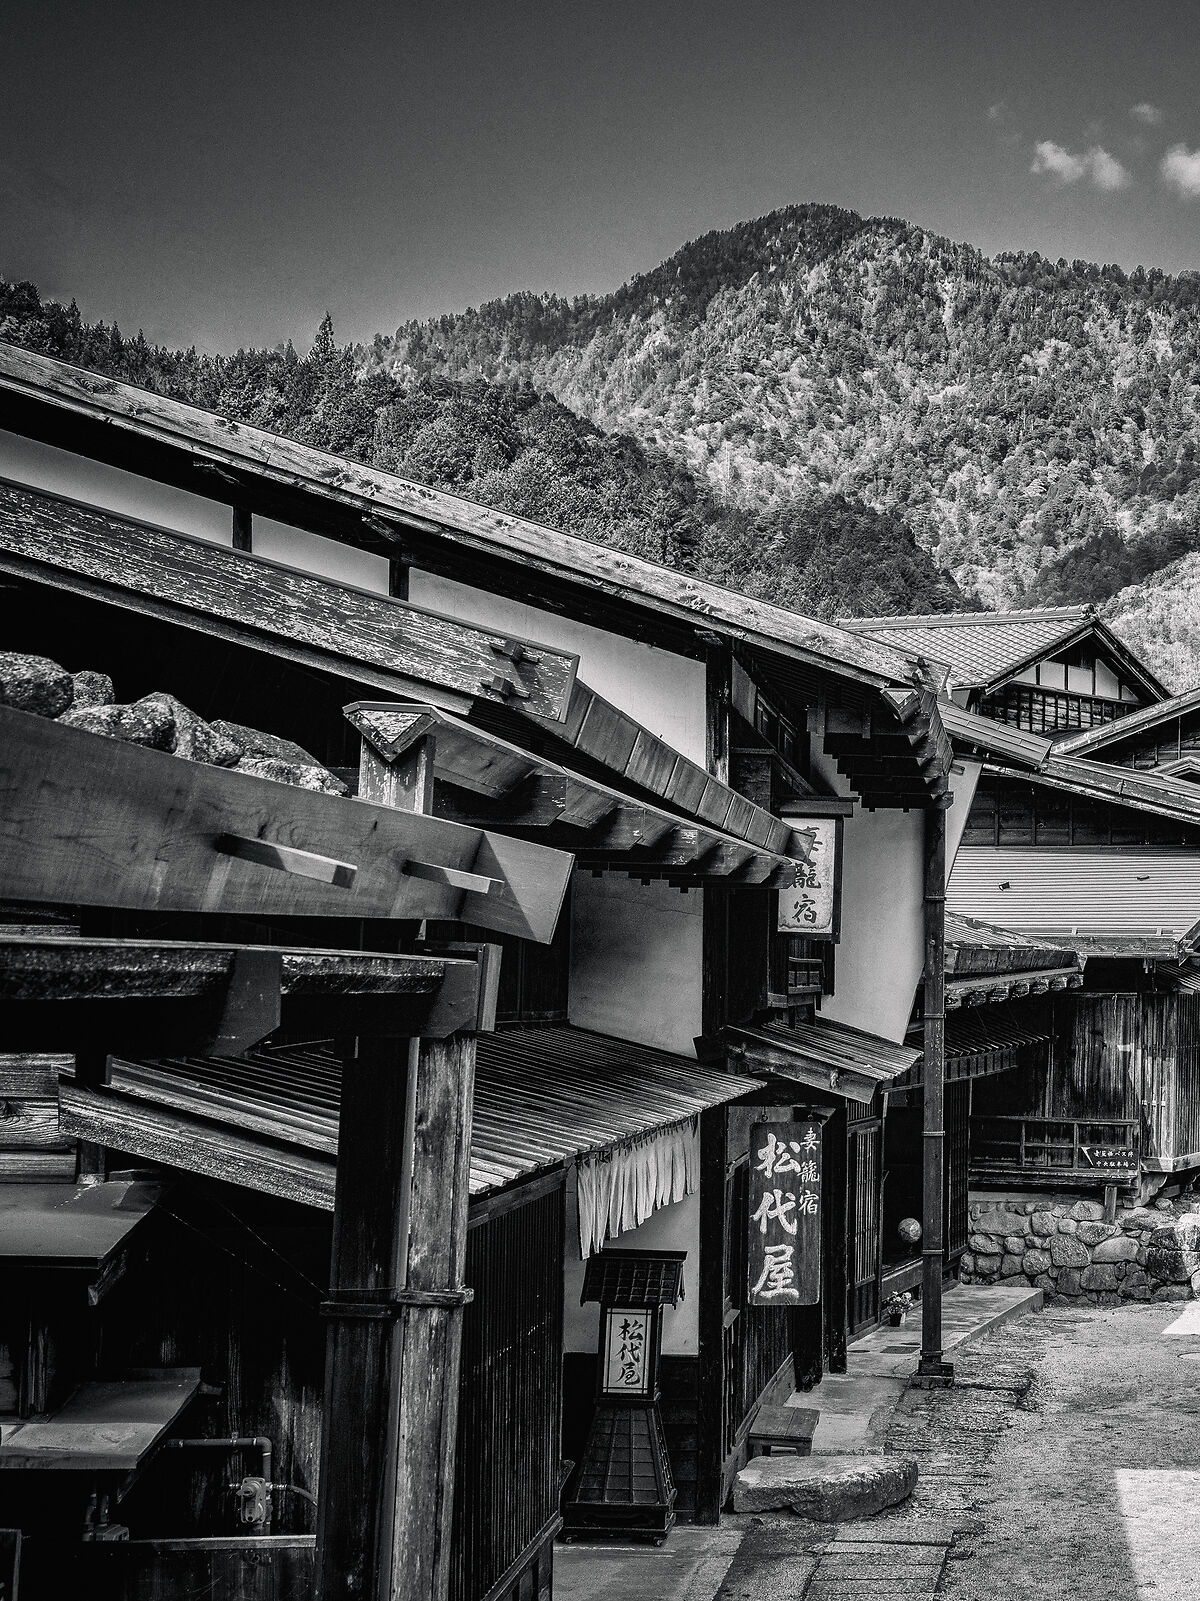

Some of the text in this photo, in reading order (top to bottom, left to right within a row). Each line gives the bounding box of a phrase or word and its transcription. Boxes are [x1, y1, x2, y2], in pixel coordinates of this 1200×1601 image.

[750, 1133, 801, 1297] 松代屋
[797, 1127, 820, 1215] 妻籠宿
[615, 1318, 644, 1386] 松代屋
